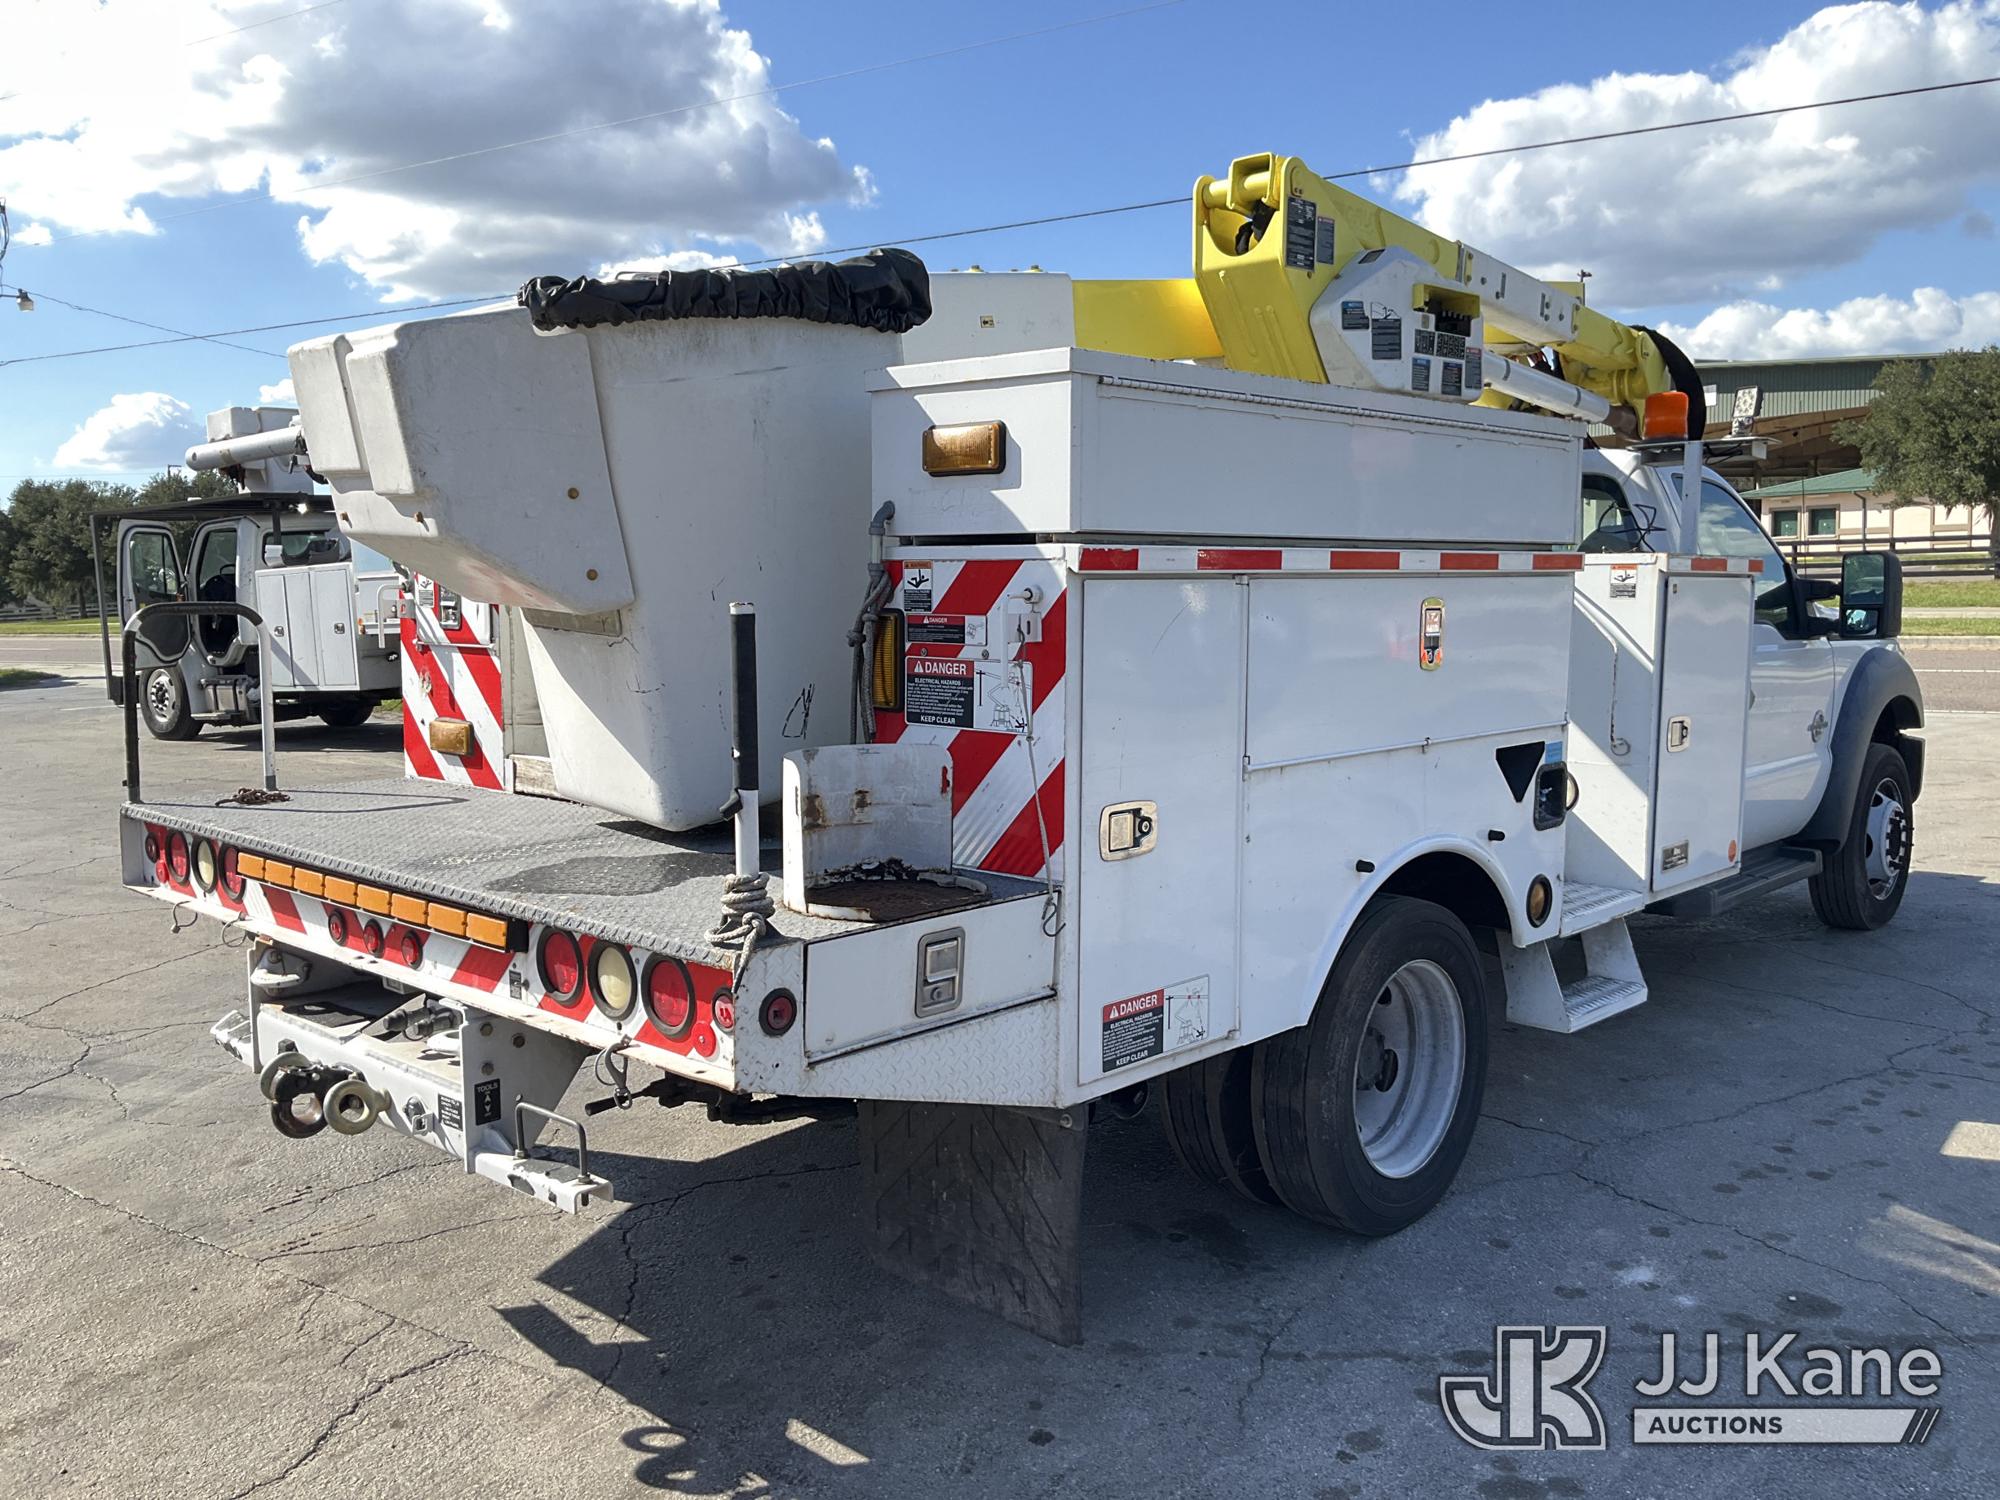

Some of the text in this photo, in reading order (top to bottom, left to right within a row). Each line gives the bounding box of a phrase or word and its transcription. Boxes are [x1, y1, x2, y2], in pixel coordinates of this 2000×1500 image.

[924, 661, 967, 676] DANGER
[1120, 994, 1158, 1015] DANGER
[1116, 1050, 1148, 1066] KEEP CLEAR
[476, 1082, 498, 1093] TOOLS
